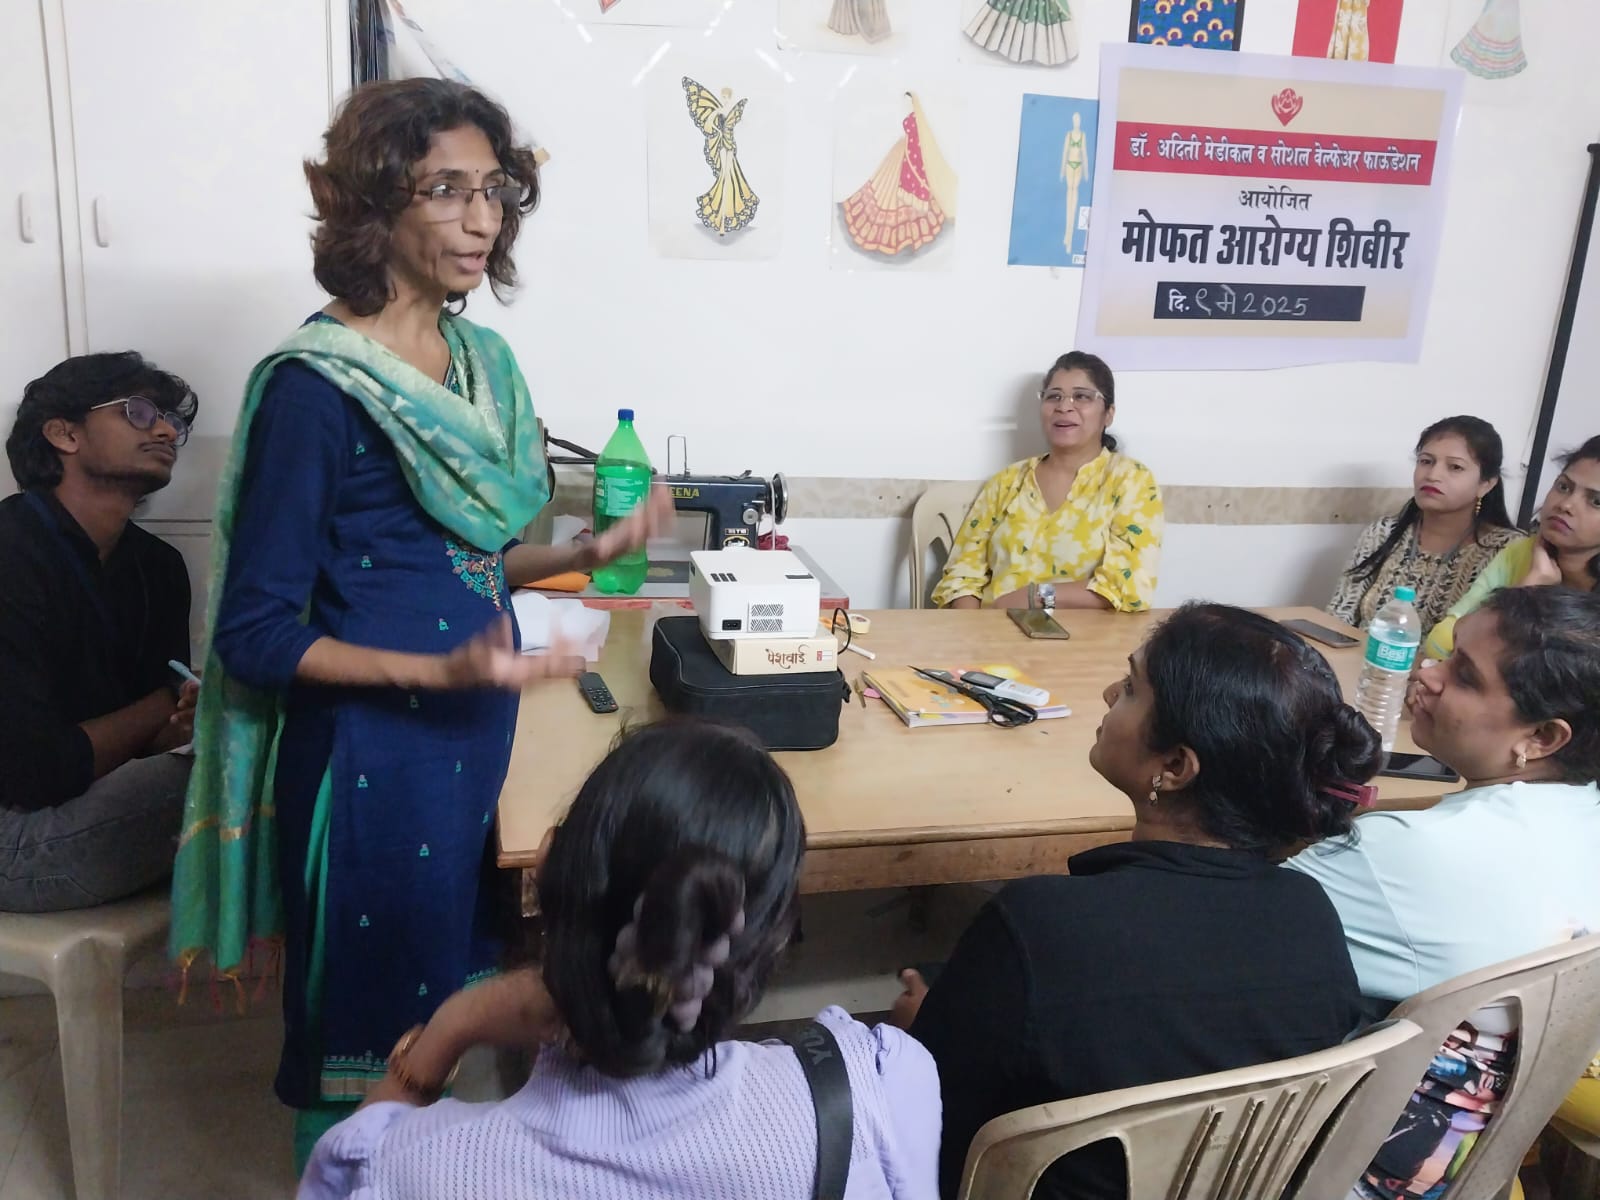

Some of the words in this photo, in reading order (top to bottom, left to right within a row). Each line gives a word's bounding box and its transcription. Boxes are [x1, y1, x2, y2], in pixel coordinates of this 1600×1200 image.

[1130, 132, 1151, 159] डॉ.
[1158, 132, 1202, 161] अदिती
[1204, 135, 1256, 163] मेडीकल
[1257, 145, 1268, 165] व
[1270, 139, 1313, 167] सोशल
[1314, 141, 1362, 172] वेल्फेअर
[1363, 145, 1422, 172] फाऊंडेशन
[1239, 184, 1313, 210] आयोजित
[1121, 208, 1214, 264] मोफत
[1216, 214, 1323, 268] आरोग्य
[1325, 217, 1411, 270] शिबीर
[1168, 288, 1190, 313] दि.
[1215, 284, 1236, 315] मे
[1242, 292, 1310, 317] 2025
[669, 486, 700, 498] EENA
[765, 643, 810, 670] पेशवाई
